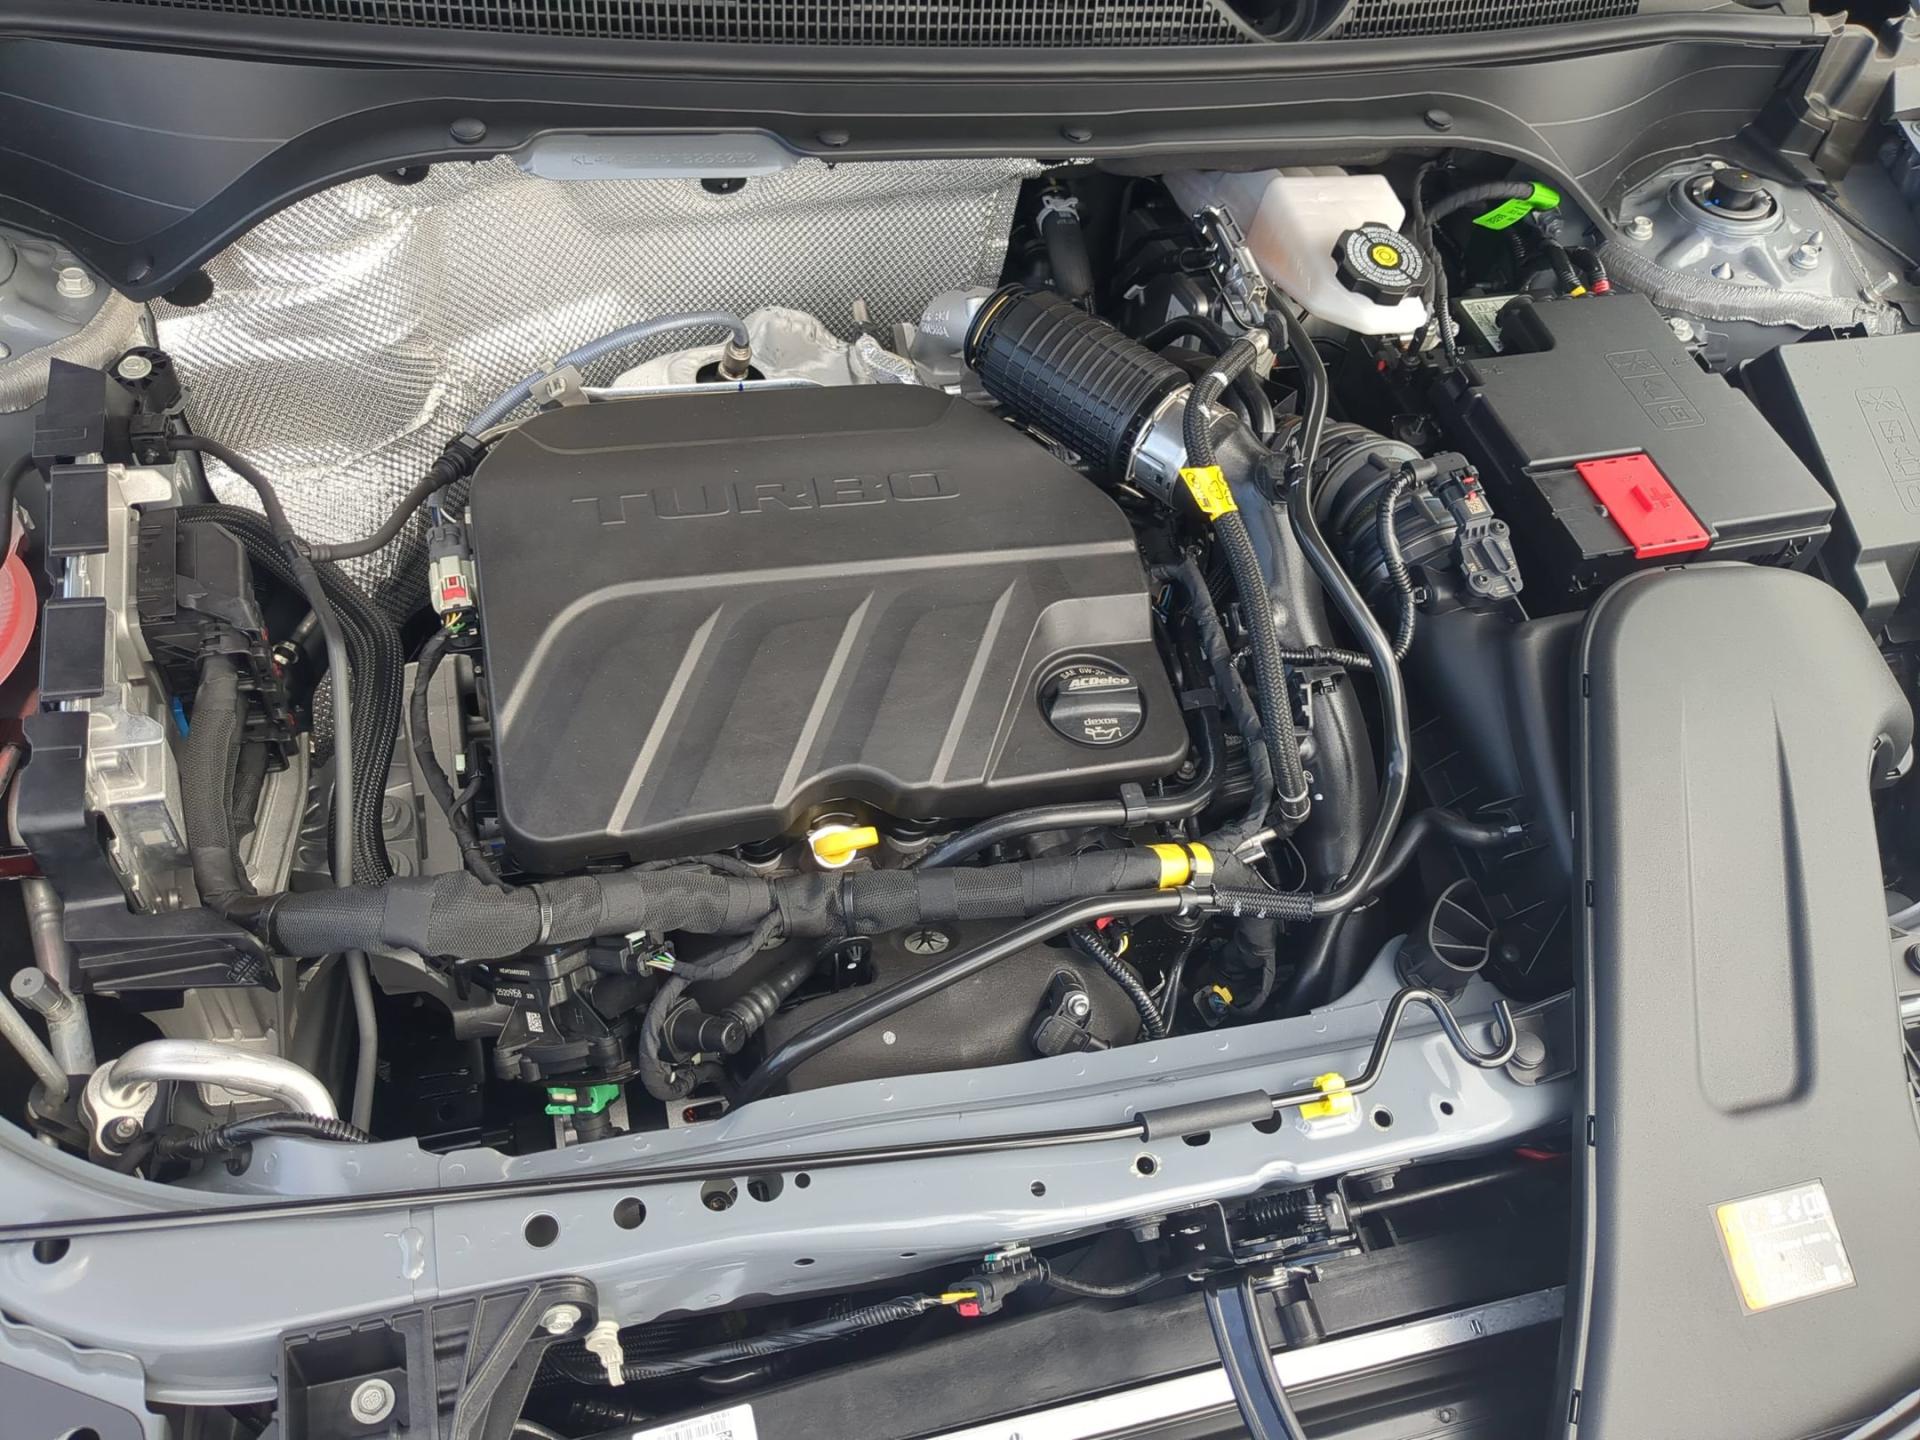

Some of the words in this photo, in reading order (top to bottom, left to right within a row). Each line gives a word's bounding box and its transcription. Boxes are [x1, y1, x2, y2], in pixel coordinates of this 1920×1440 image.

[571, 472, 962, 526] TURBO
[1068, 676, 1130, 689] ACDelco
[1083, 717, 1119, 726] dexos
